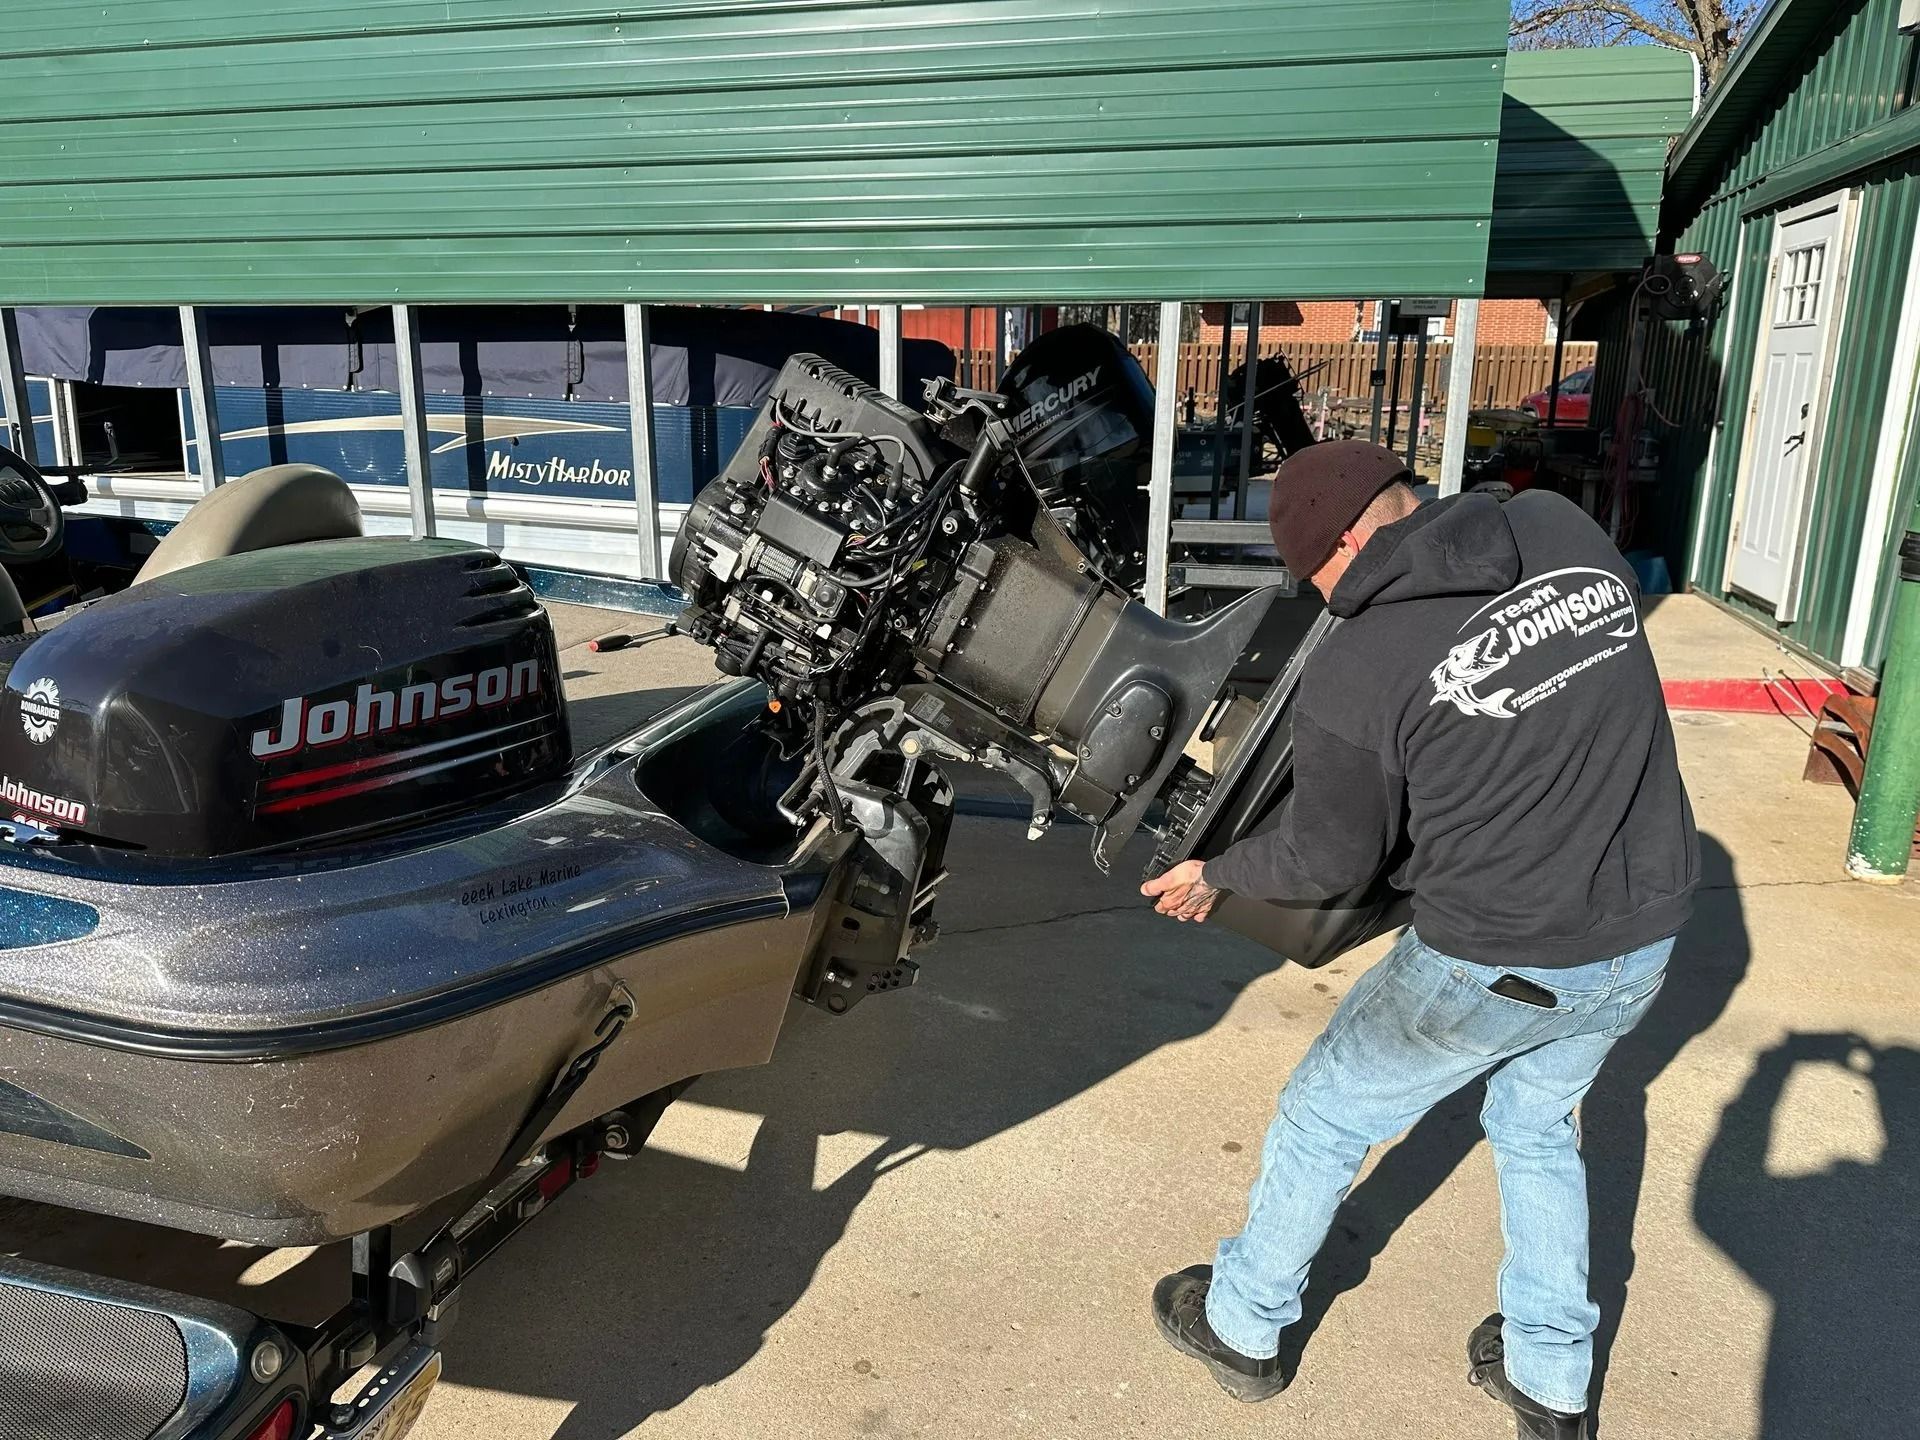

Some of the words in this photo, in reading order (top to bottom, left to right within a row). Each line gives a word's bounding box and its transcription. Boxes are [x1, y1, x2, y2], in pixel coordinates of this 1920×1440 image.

[1578, 617, 1605, 637] BOATS
[21, 699, 60, 720] BOMBARDIER
[251, 658, 539, 761] Johnson
[0, 775, 87, 824] Johnson
[501, 875, 534, 896] Lake
[540, 864, 581, 886] Marine
